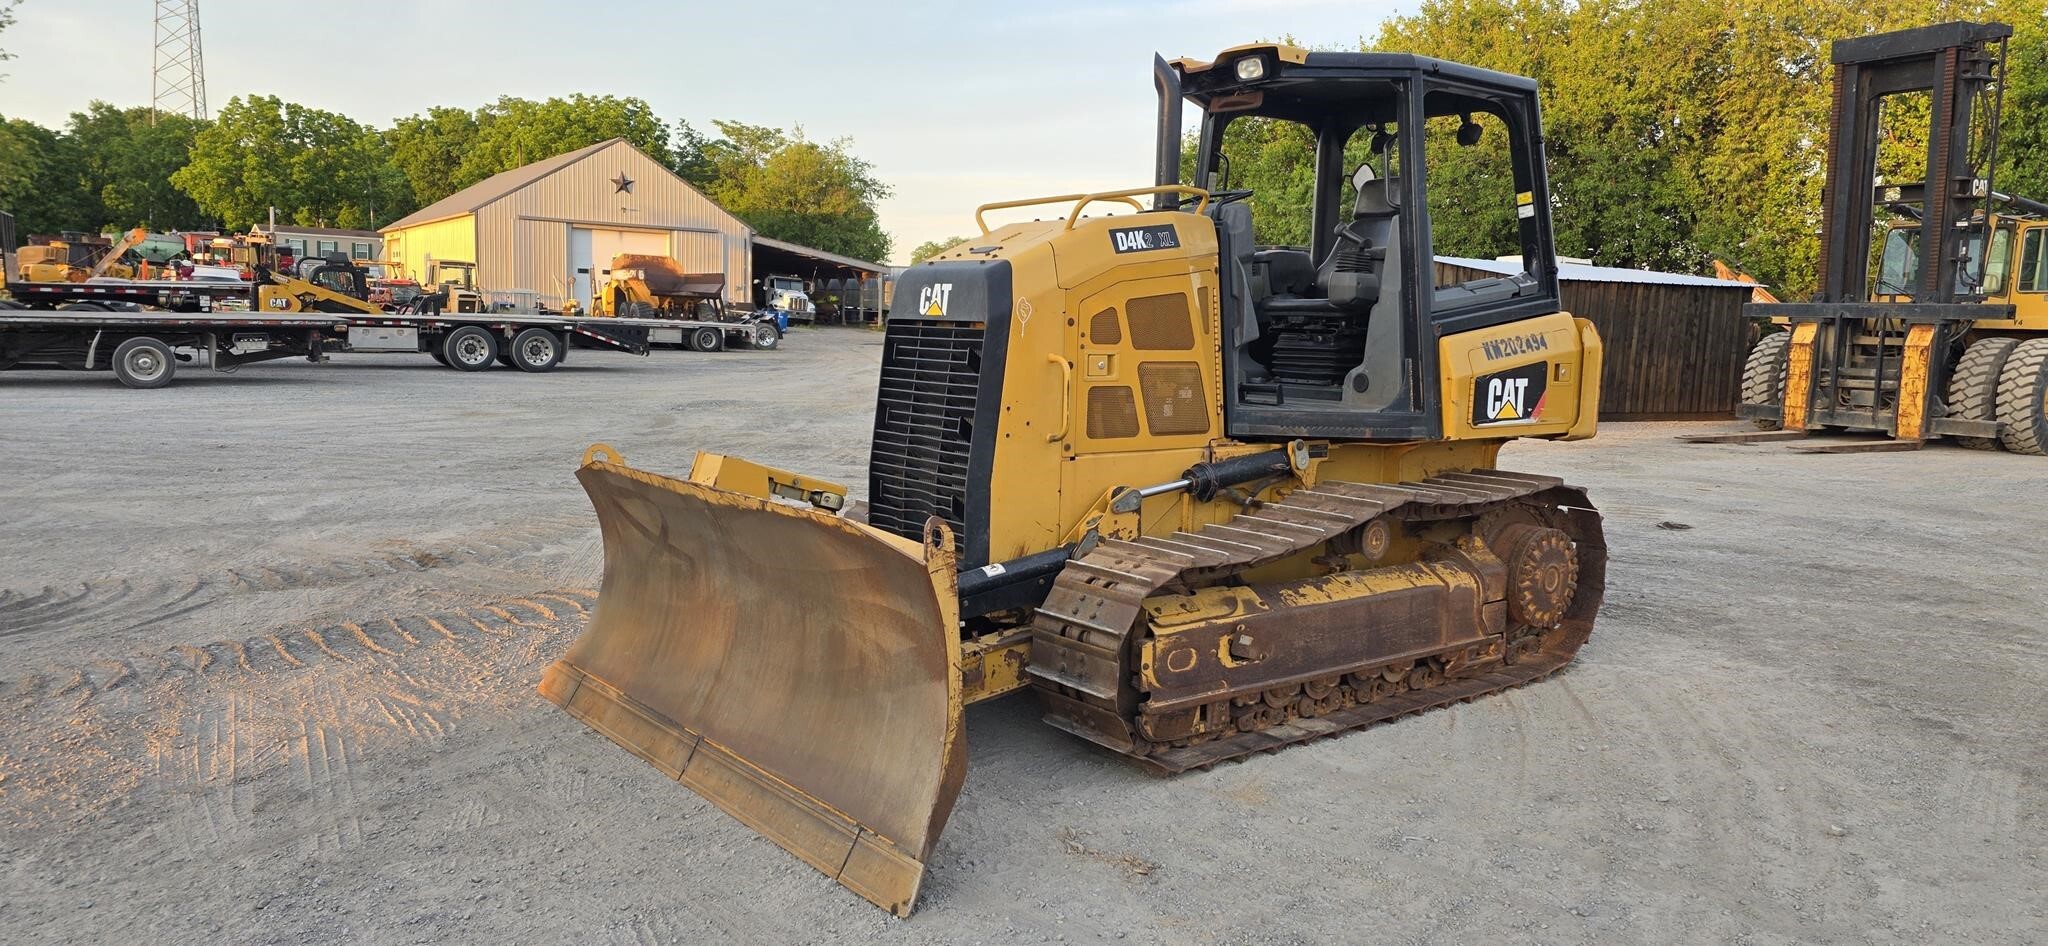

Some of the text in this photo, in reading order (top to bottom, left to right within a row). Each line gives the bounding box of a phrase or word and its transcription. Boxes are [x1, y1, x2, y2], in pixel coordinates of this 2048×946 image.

[1972, 178, 1988, 196] CAT
[1115, 230, 1175, 251] D4K2 XL
[270, 298, 287, 308] CAT
[919, 283, 952, 316] CAT
[1487, 377, 1528, 420] CAT
